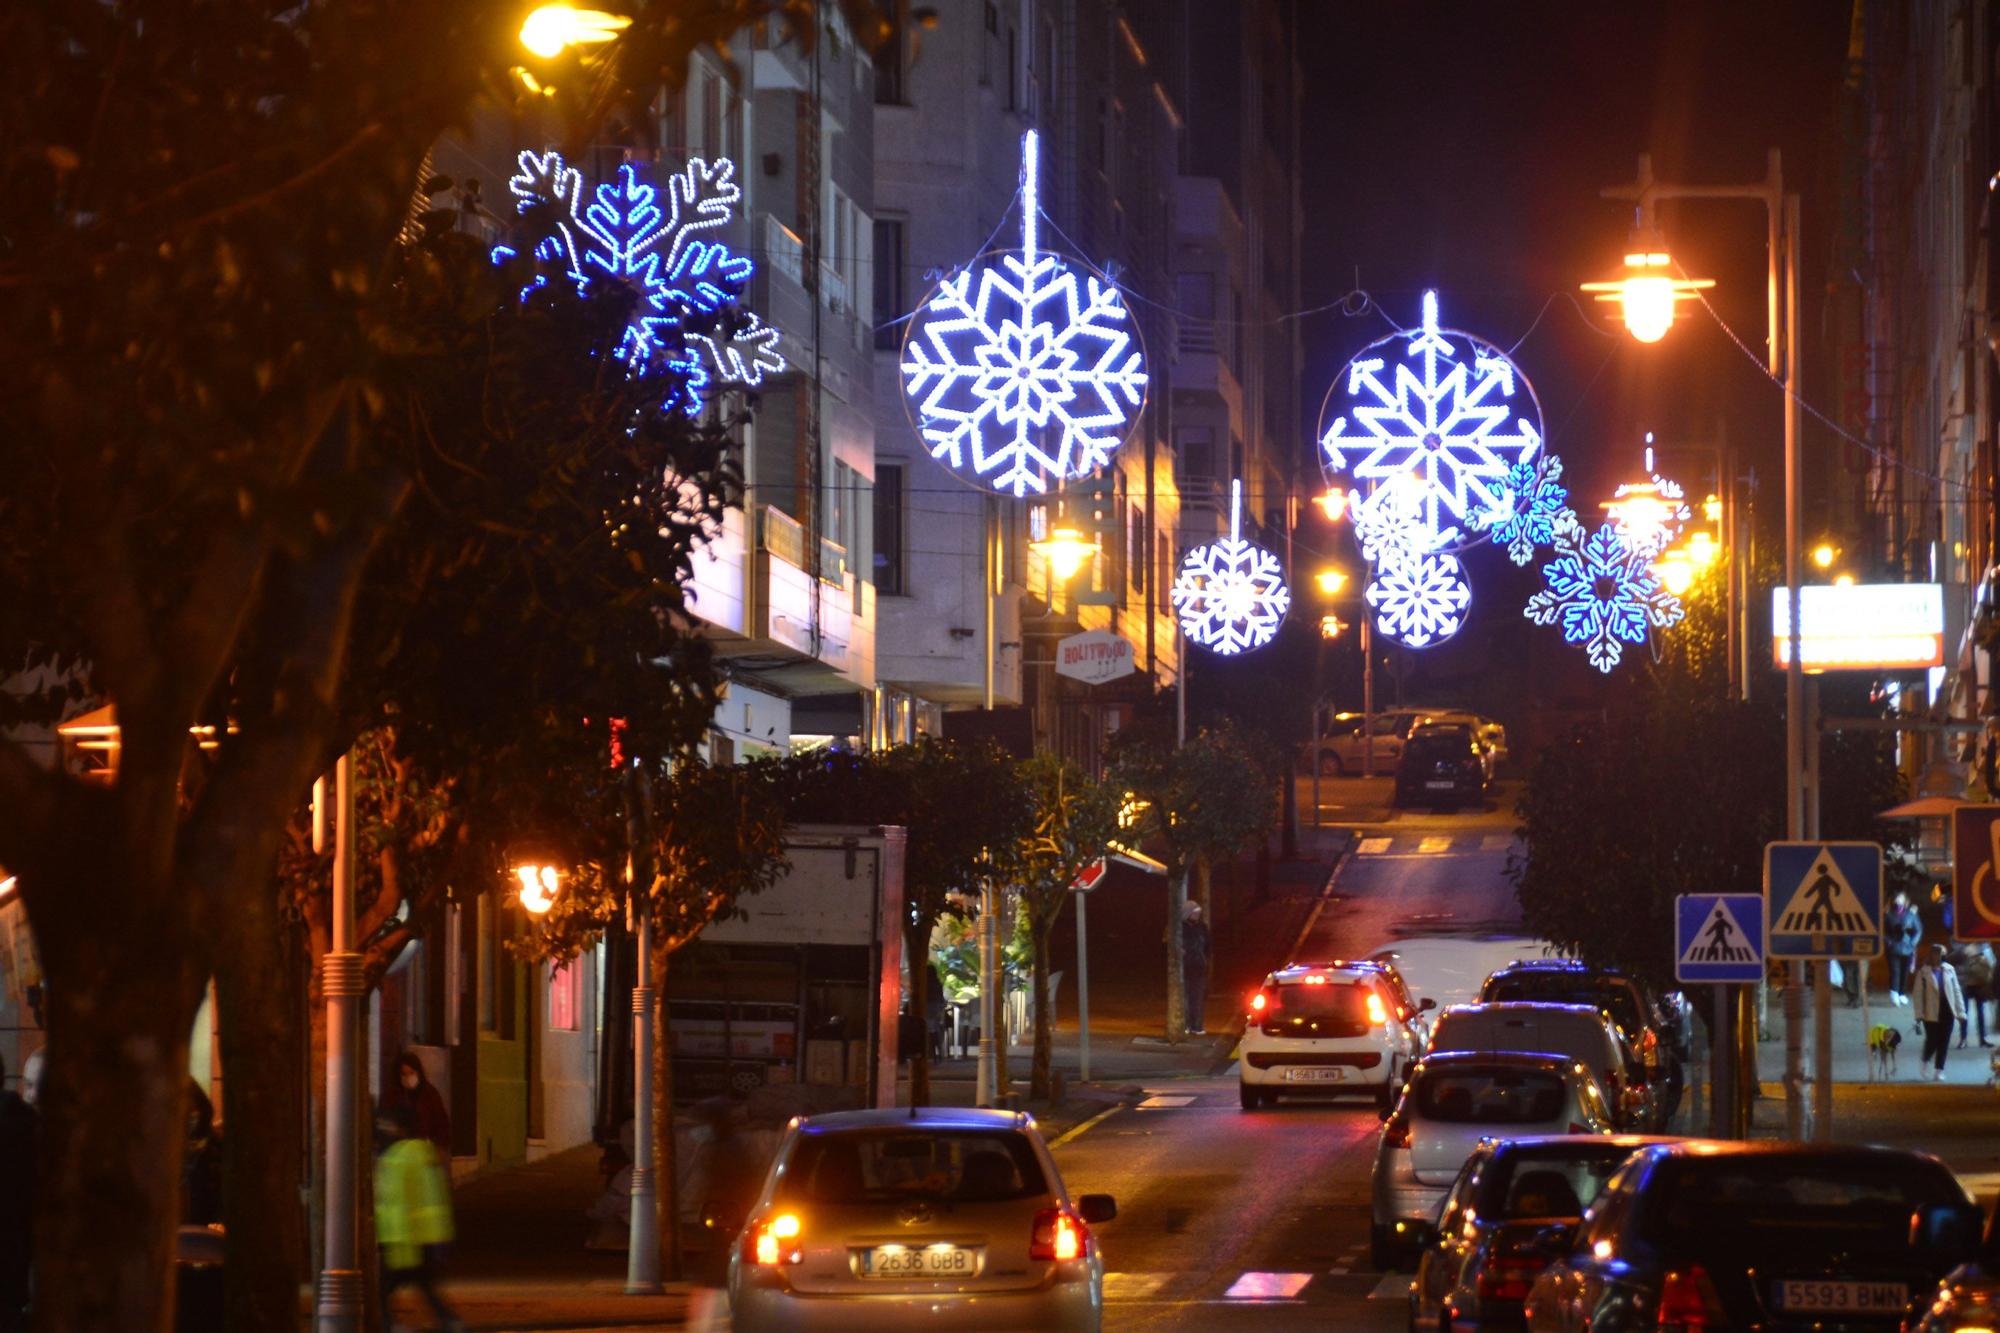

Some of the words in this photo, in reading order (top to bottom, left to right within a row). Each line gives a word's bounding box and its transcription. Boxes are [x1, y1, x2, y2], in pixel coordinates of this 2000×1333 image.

[879, 1252, 924, 1271] 2636
[930, 1251, 965, 1270] GBB
[1789, 1284, 1848, 1307] 5593
[1857, 1286, 1901, 1307] BMN
